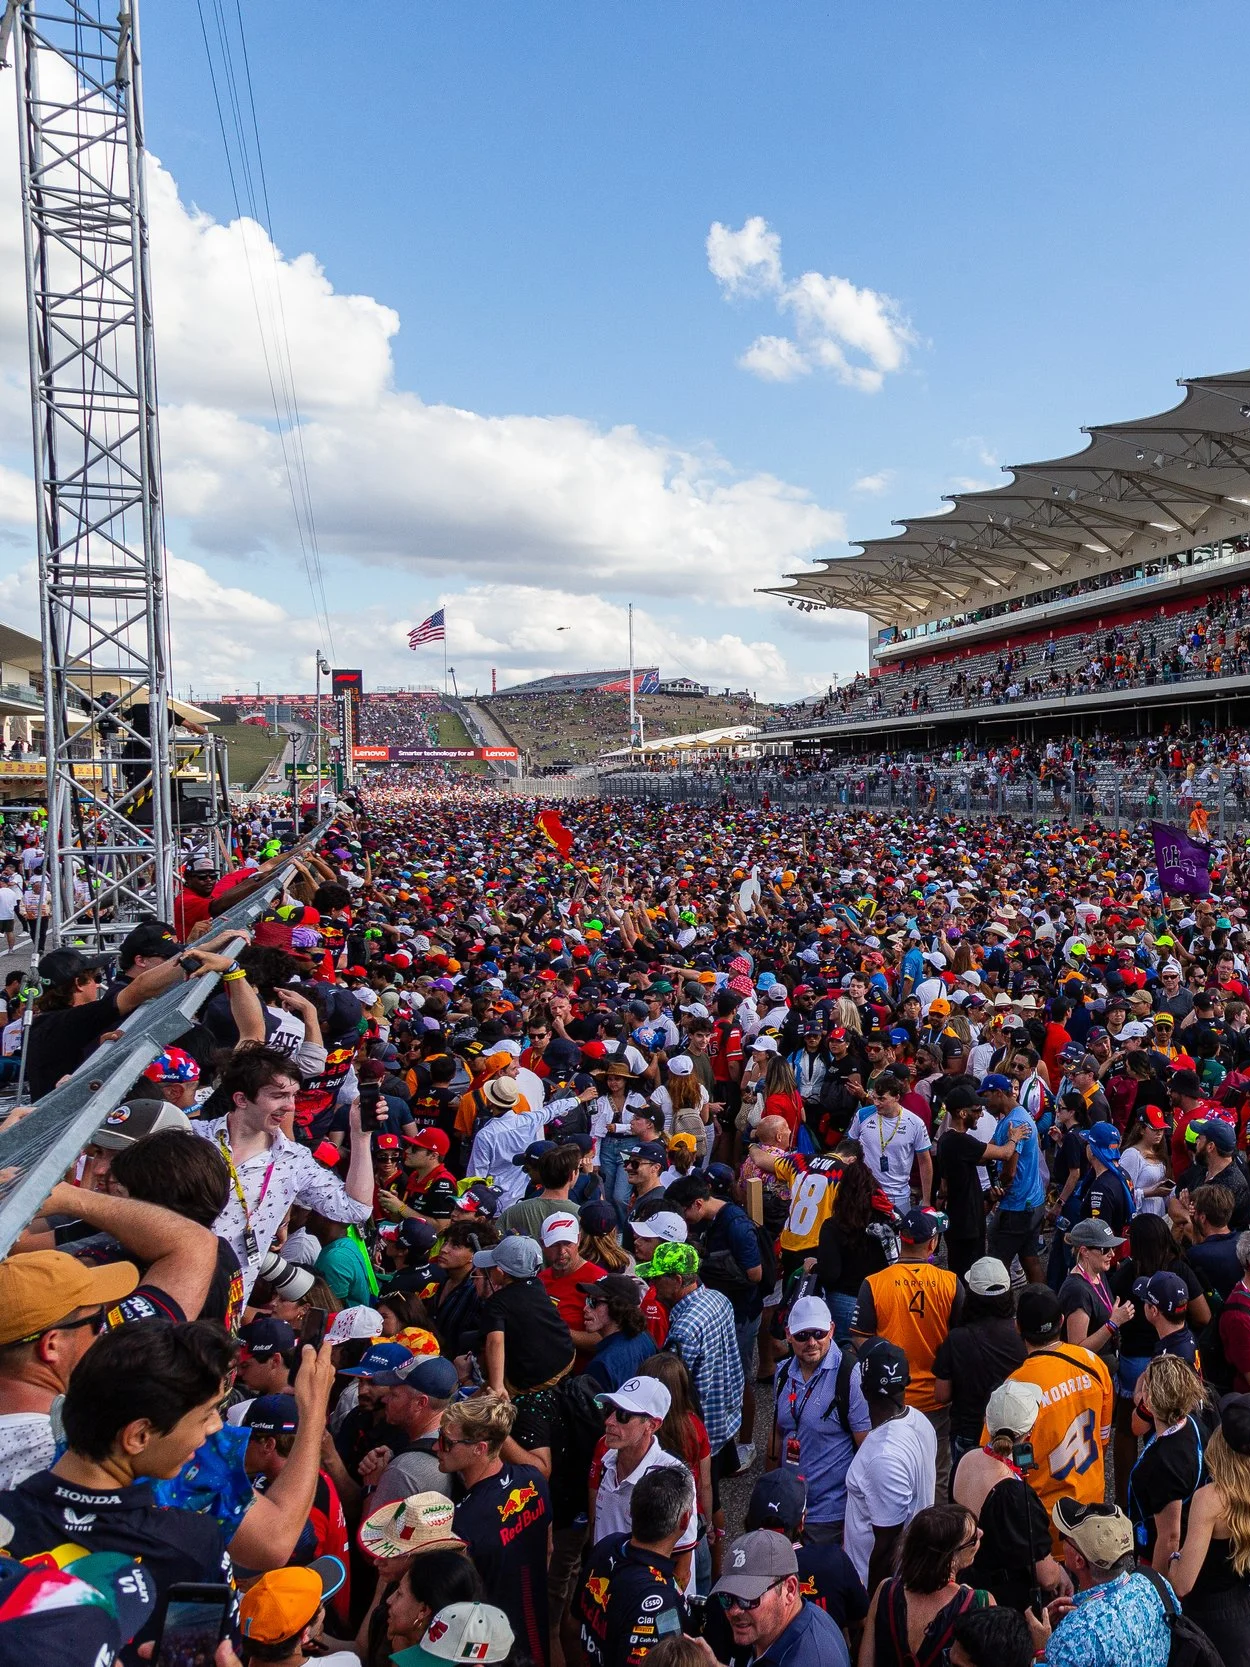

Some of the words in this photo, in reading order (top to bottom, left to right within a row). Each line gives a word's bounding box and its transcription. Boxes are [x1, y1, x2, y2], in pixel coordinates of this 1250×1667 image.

[354, 749, 387, 757] Lenovo
[423, 750, 457, 758] technology
[485, 749, 515, 758] Lenovo
[156, 1072, 180, 1080] cognizant
[788, 1170, 829, 1237] 18
[894, 1278, 937, 1289] NORRIS
[908, 1290, 926, 1319] 4
[252, 1343, 273, 1351] telcel
[1040, 1373, 1092, 1408] NORRIS
[250, 1421, 274, 1429] CarNext
[54, 1486, 122, 1505] HONDA
[500, 1520, 524, 1547] Red
[522, 1498, 546, 1528] Bull
